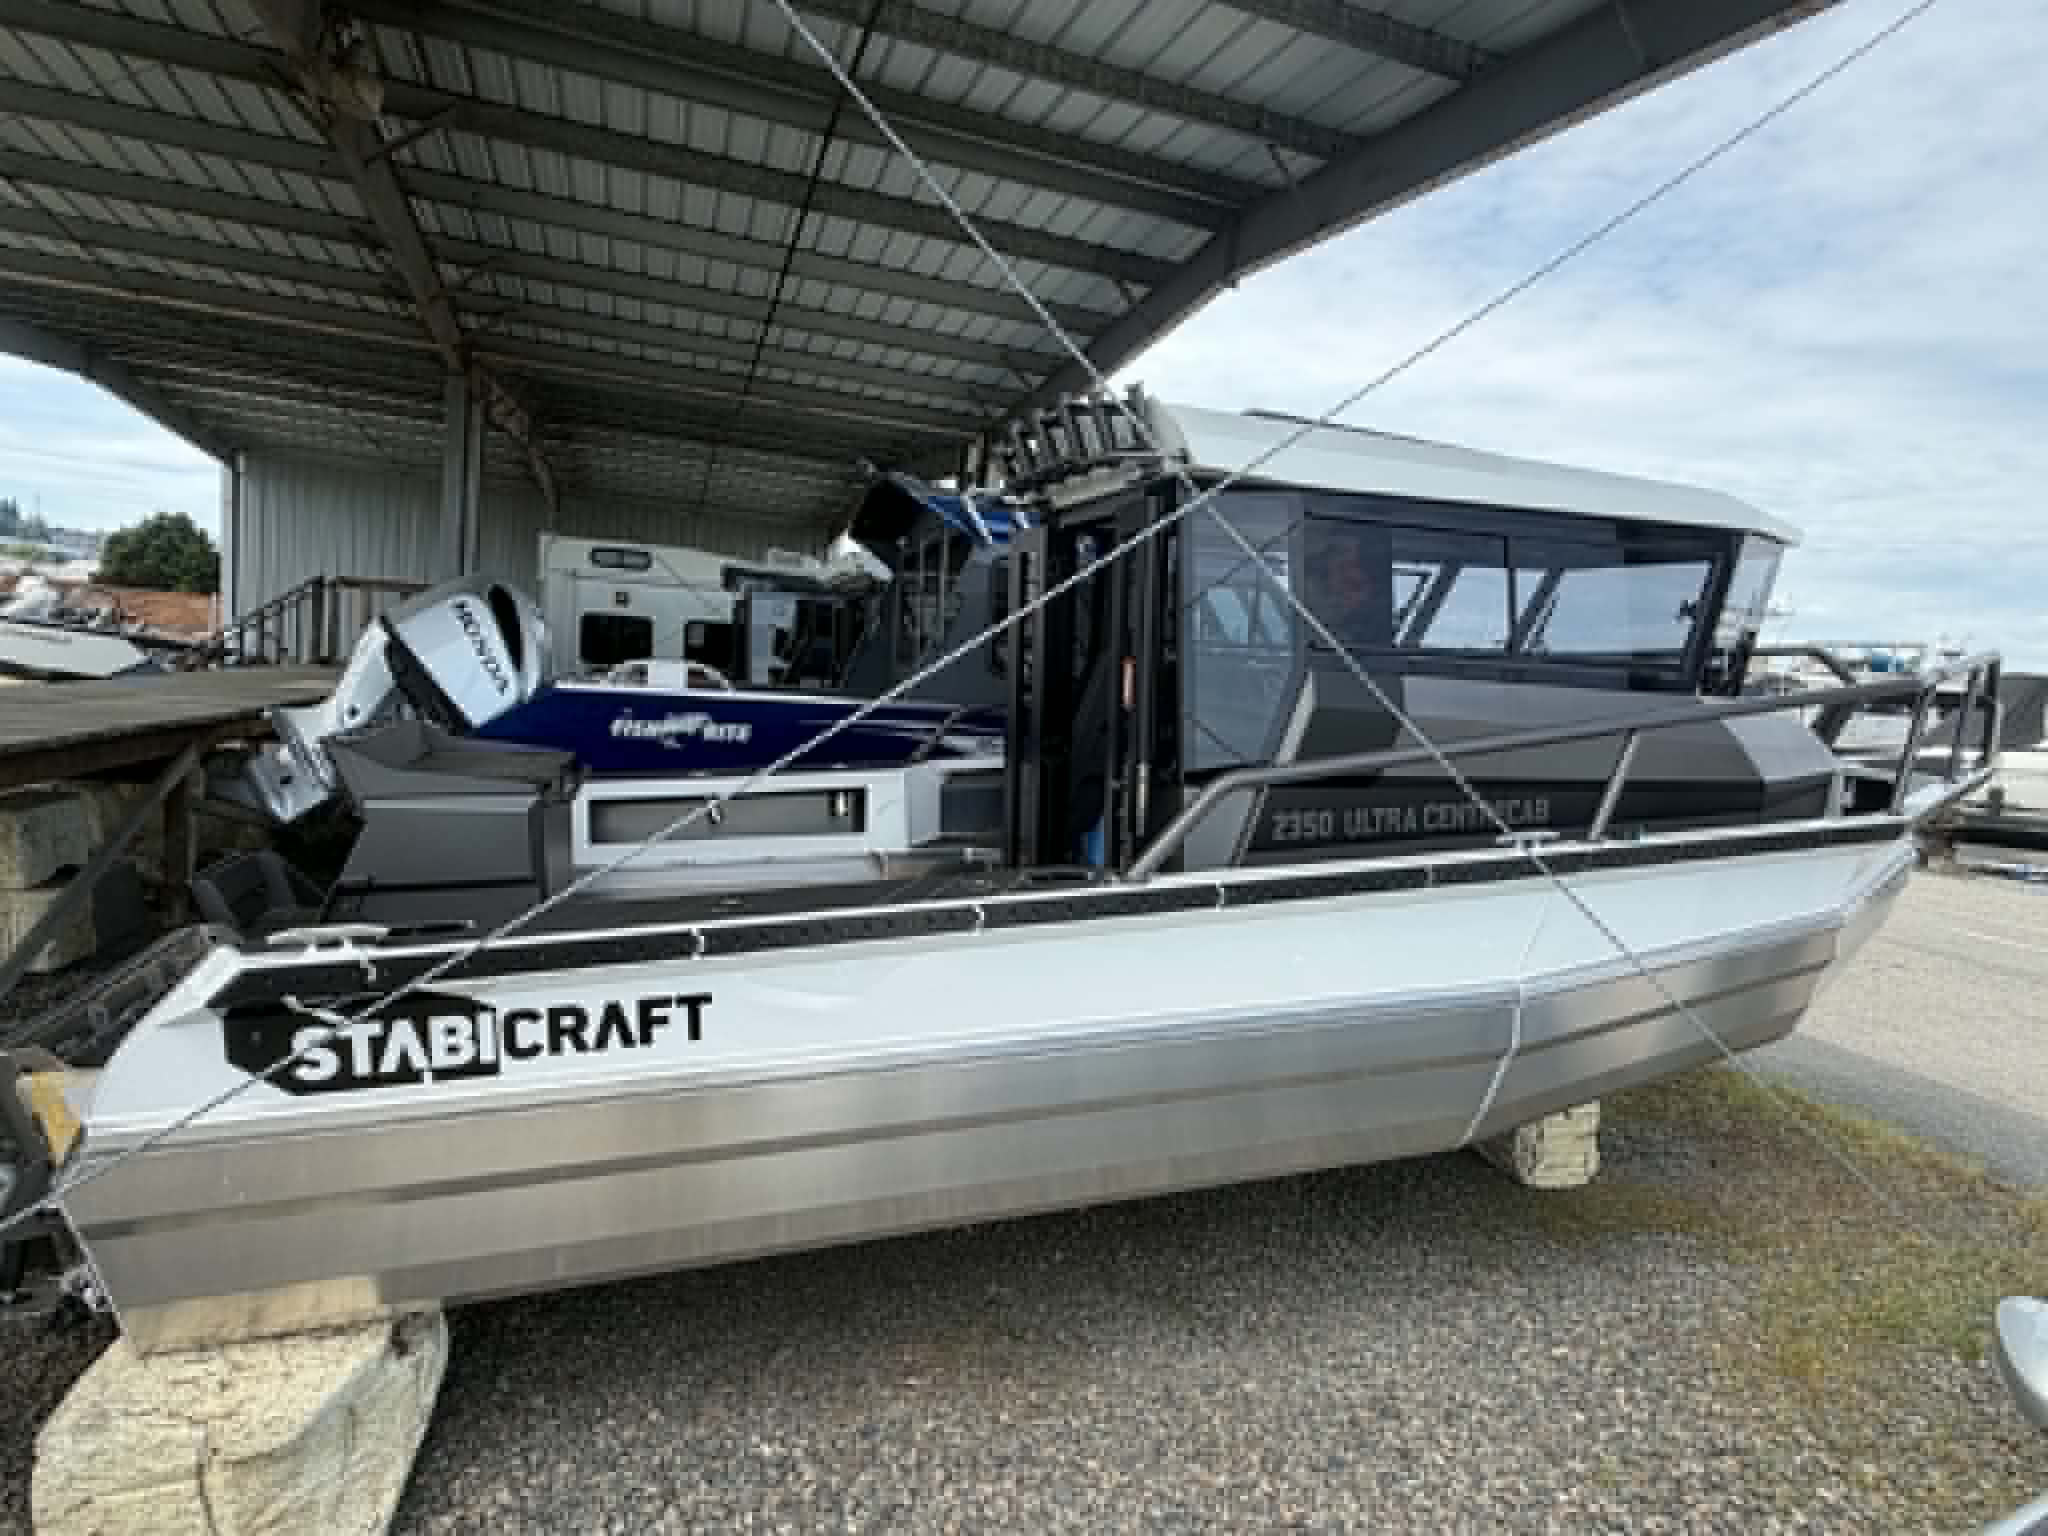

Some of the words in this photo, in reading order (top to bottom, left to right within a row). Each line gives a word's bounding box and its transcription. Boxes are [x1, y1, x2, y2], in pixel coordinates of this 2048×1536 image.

[452, 598, 511, 697] HONDA
[1271, 808, 1335, 841] 2350
[1344, 804, 1417, 837] ULTRA
[289, 991, 714, 1082] STABICRAFT
